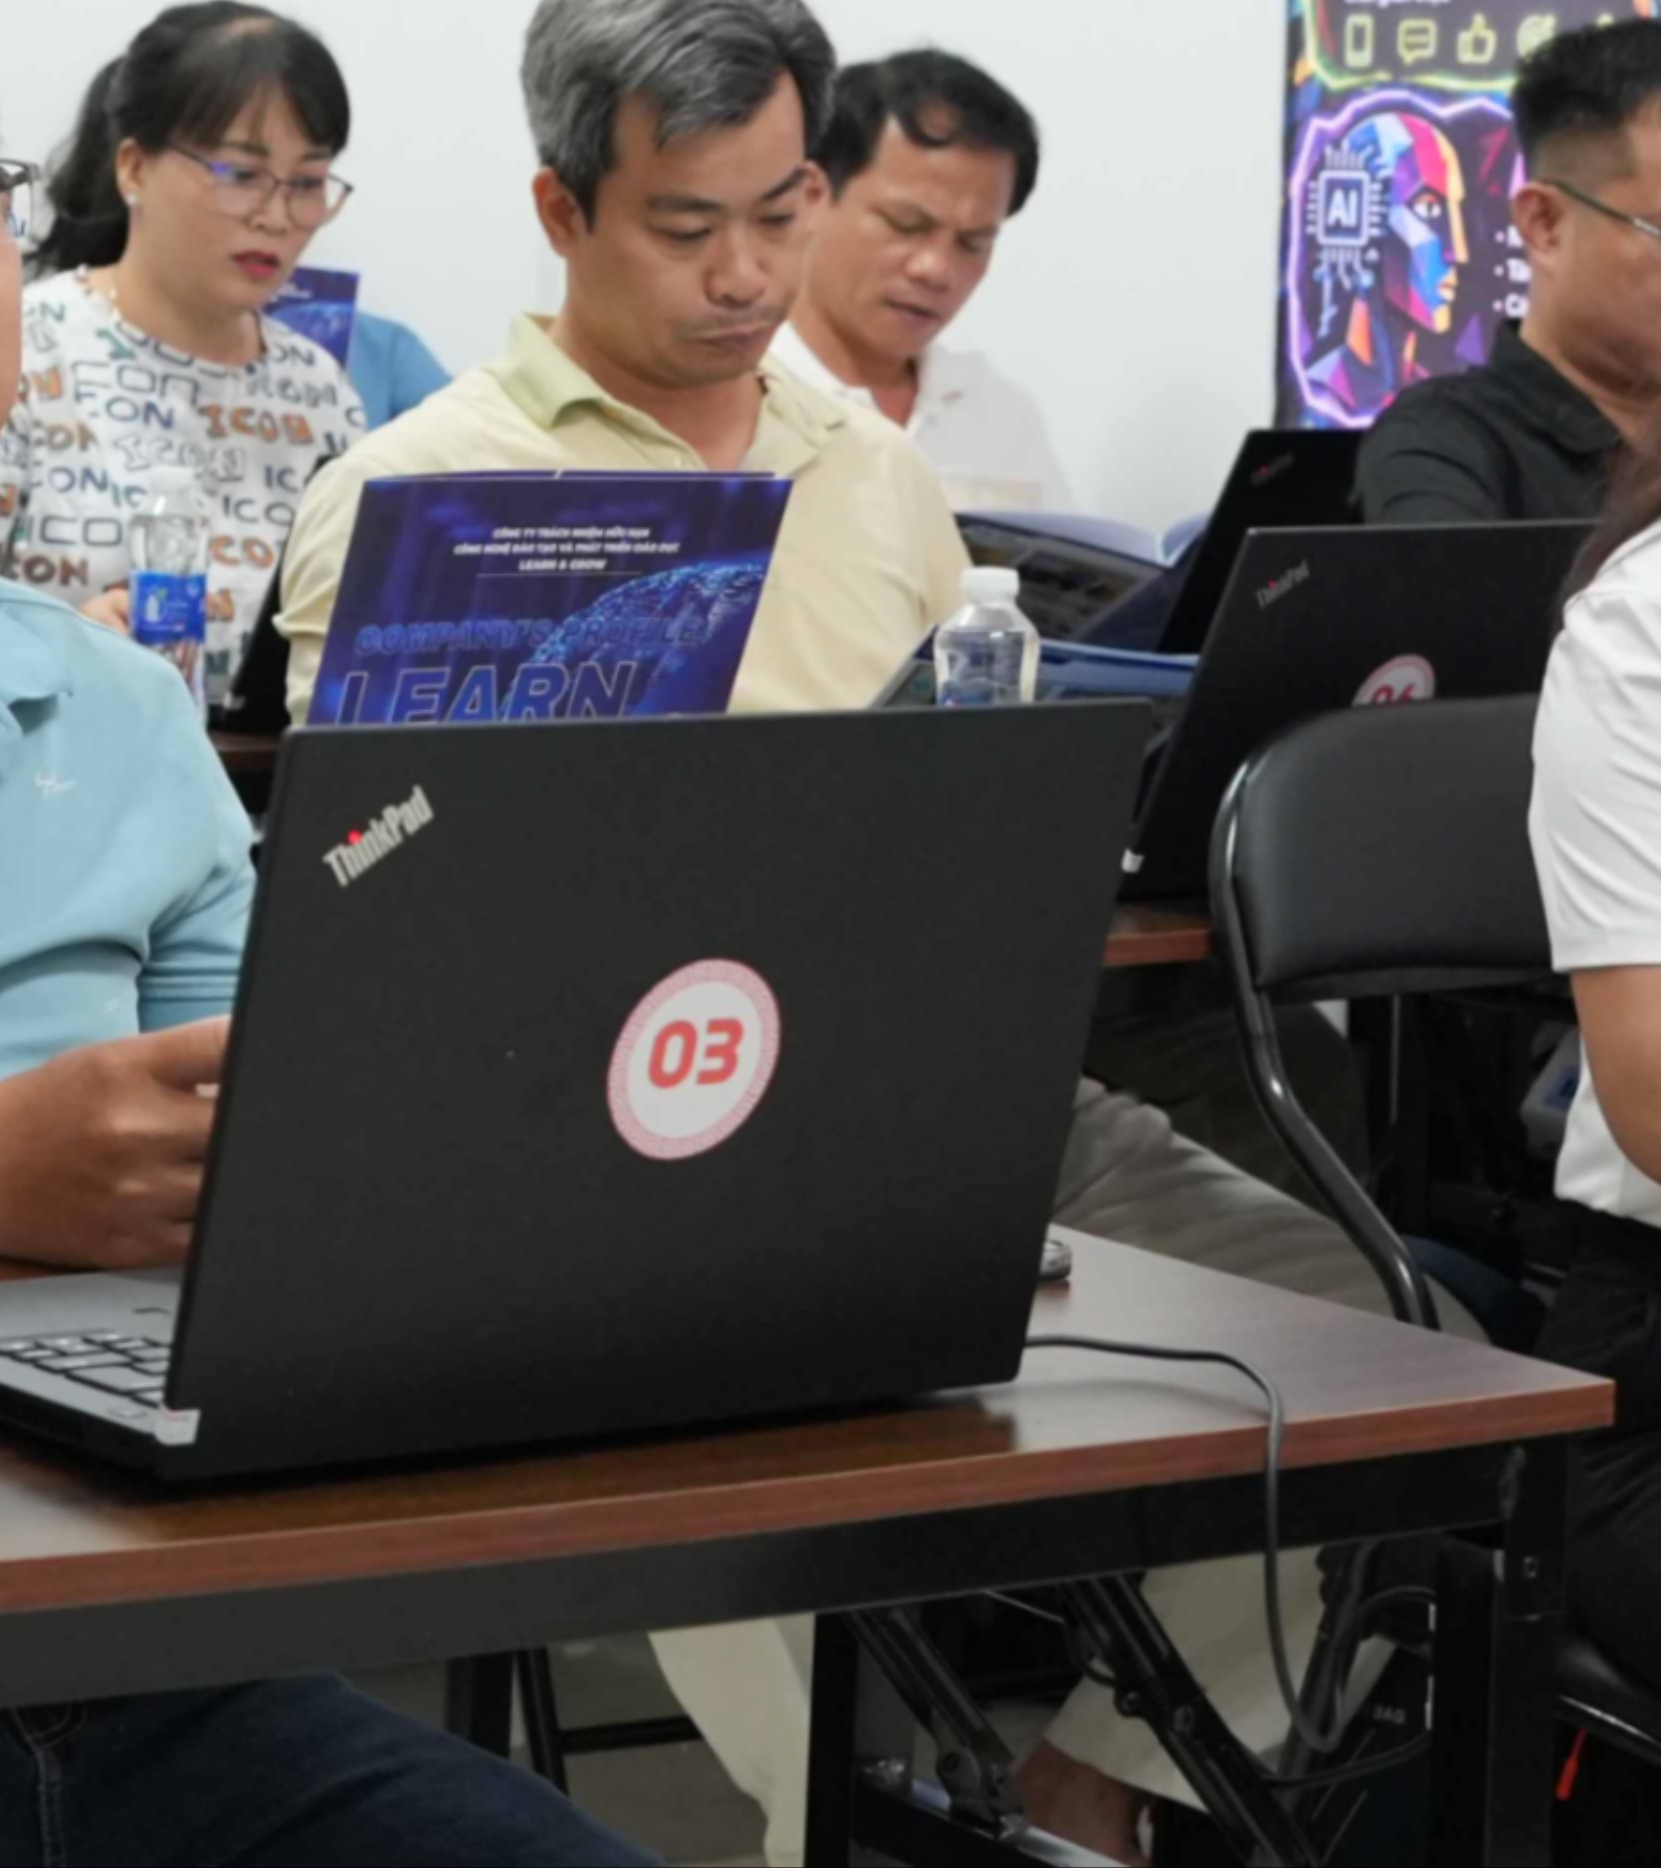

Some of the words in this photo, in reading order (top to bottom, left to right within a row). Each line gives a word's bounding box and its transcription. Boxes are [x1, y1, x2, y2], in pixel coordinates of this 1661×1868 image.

[1327, 188, 1360, 227] AI
[320, 784, 435, 887] ThinkPad
[645, 1016, 745, 1089] 03
